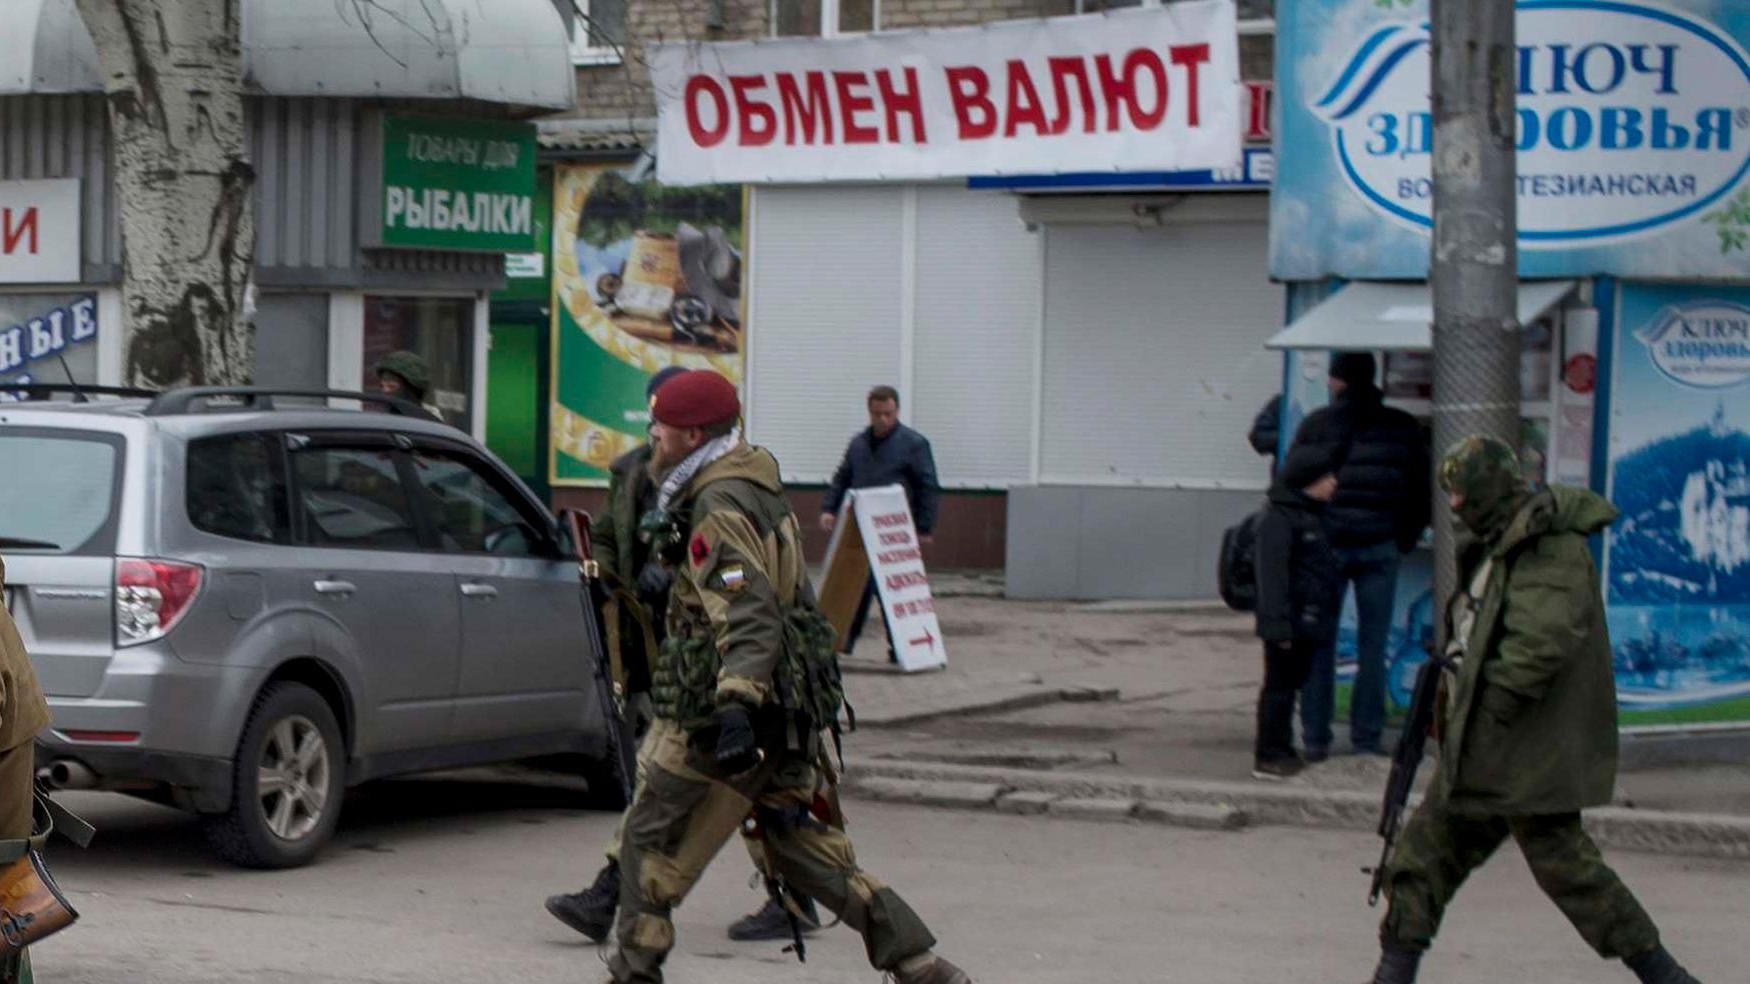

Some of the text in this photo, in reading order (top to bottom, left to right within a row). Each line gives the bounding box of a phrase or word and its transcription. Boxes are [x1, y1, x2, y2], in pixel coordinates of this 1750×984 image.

[684, 67, 927, 148] ОБМЕН
[944, 43, 1210, 140] ВАЛЮТ
[386, 185, 531, 235] РЫБАЛКИ
[1516, 174, 1696, 197] ТЕЗИАНСКАЯ
